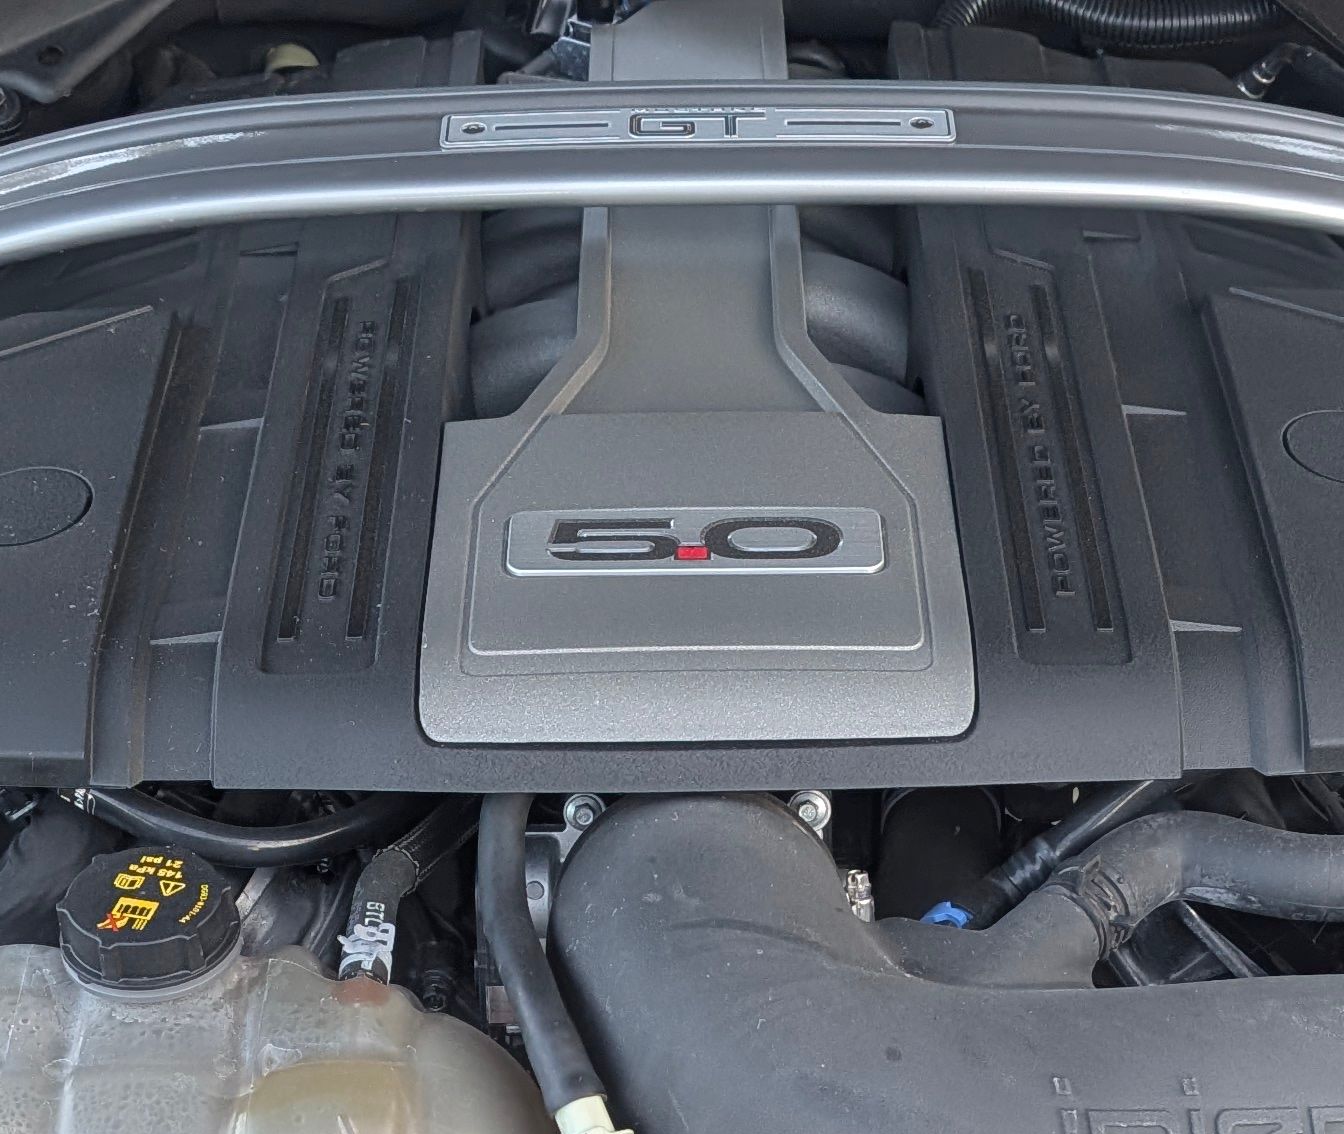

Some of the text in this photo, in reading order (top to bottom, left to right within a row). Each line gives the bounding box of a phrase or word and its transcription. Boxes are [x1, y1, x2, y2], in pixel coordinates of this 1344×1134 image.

[628, 112, 767, 139] GT
[317, 320, 376, 600] POWERED BY FORD
[1008, 314, 1076, 597] POWERED BY FORD
[547, 517, 844, 562] 5.0
[128, 863, 156, 875] kPa
[139, 855, 184, 869] 21 psi
